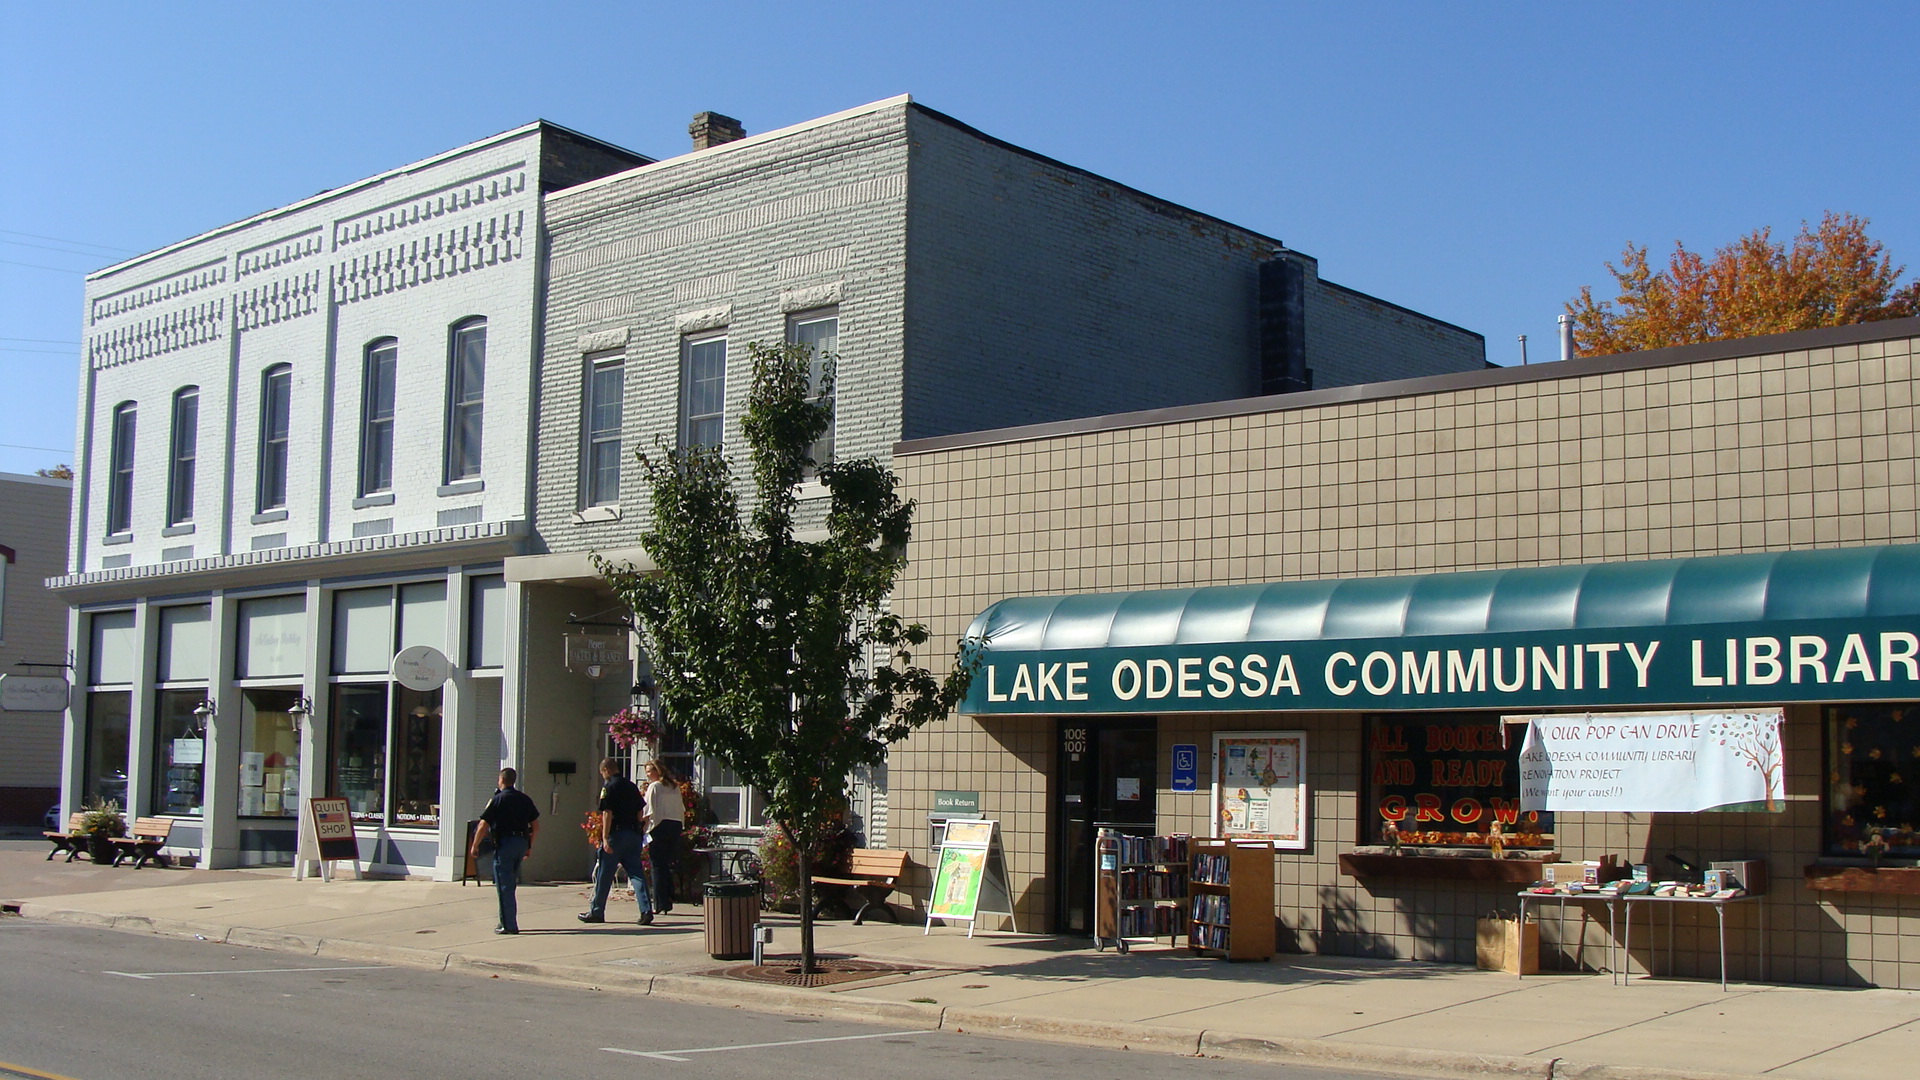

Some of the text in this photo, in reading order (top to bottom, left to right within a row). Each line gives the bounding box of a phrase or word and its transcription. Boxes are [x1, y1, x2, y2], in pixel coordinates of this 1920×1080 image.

[987, 631, 1919, 702] LAKE ODESSA COMMUNITY LIBRAR
[1369, 724, 1512, 753] ALL BOOKED
[1551, 726, 1580, 740] OUR
[1586, 725, 1616, 740] POP
[1620, 725, 1652, 739] CAN
[1656, 724, 1701, 739] DRIVE
[1545, 751, 1582, 763] ODESSA
[1585, 750, 1648, 764] COMMUNITY
[1651, 750, 1697, 763] LIBRARY
[1373, 759, 1507, 787] AND READY
[1522, 769, 1623, 782] RENOVATION PROJECT
[1562, 788, 1586, 800] your
[1588, 786, 1623, 798] cans!!)
[314, 802, 346, 813] QUILT
[937, 798, 975, 807] Book Return
[321, 824, 346, 834] SHOP
